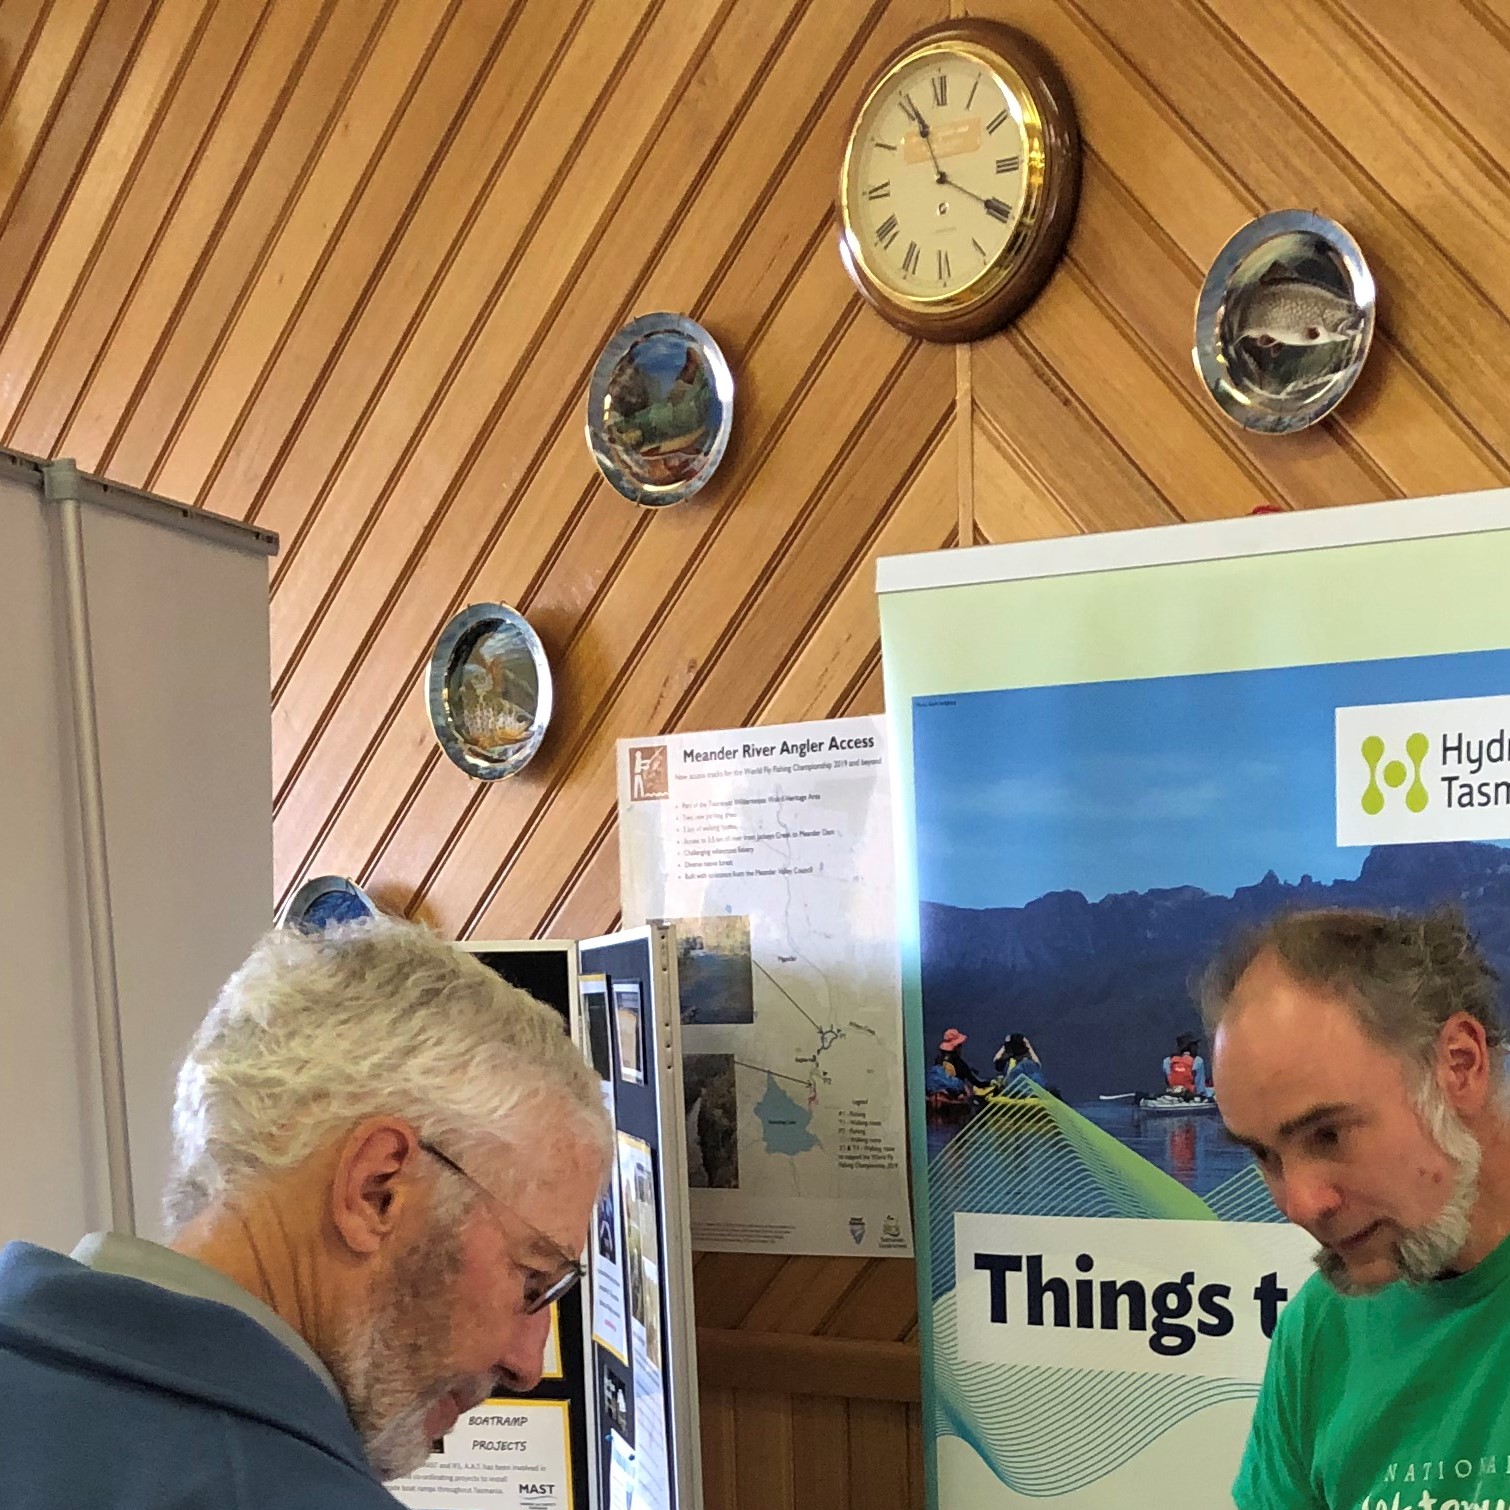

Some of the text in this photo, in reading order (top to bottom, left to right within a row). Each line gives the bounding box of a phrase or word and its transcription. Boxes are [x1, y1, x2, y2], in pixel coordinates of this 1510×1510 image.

[683, 736, 875, 763] Meander River Angler Access
[974, 1252, 1288, 1356] Things t
[468, 1415, 528, 1427] BOATRAMP
[472, 1439, 528, 1451] PROJECTS
[519, 1483, 555, 1494] MAST
